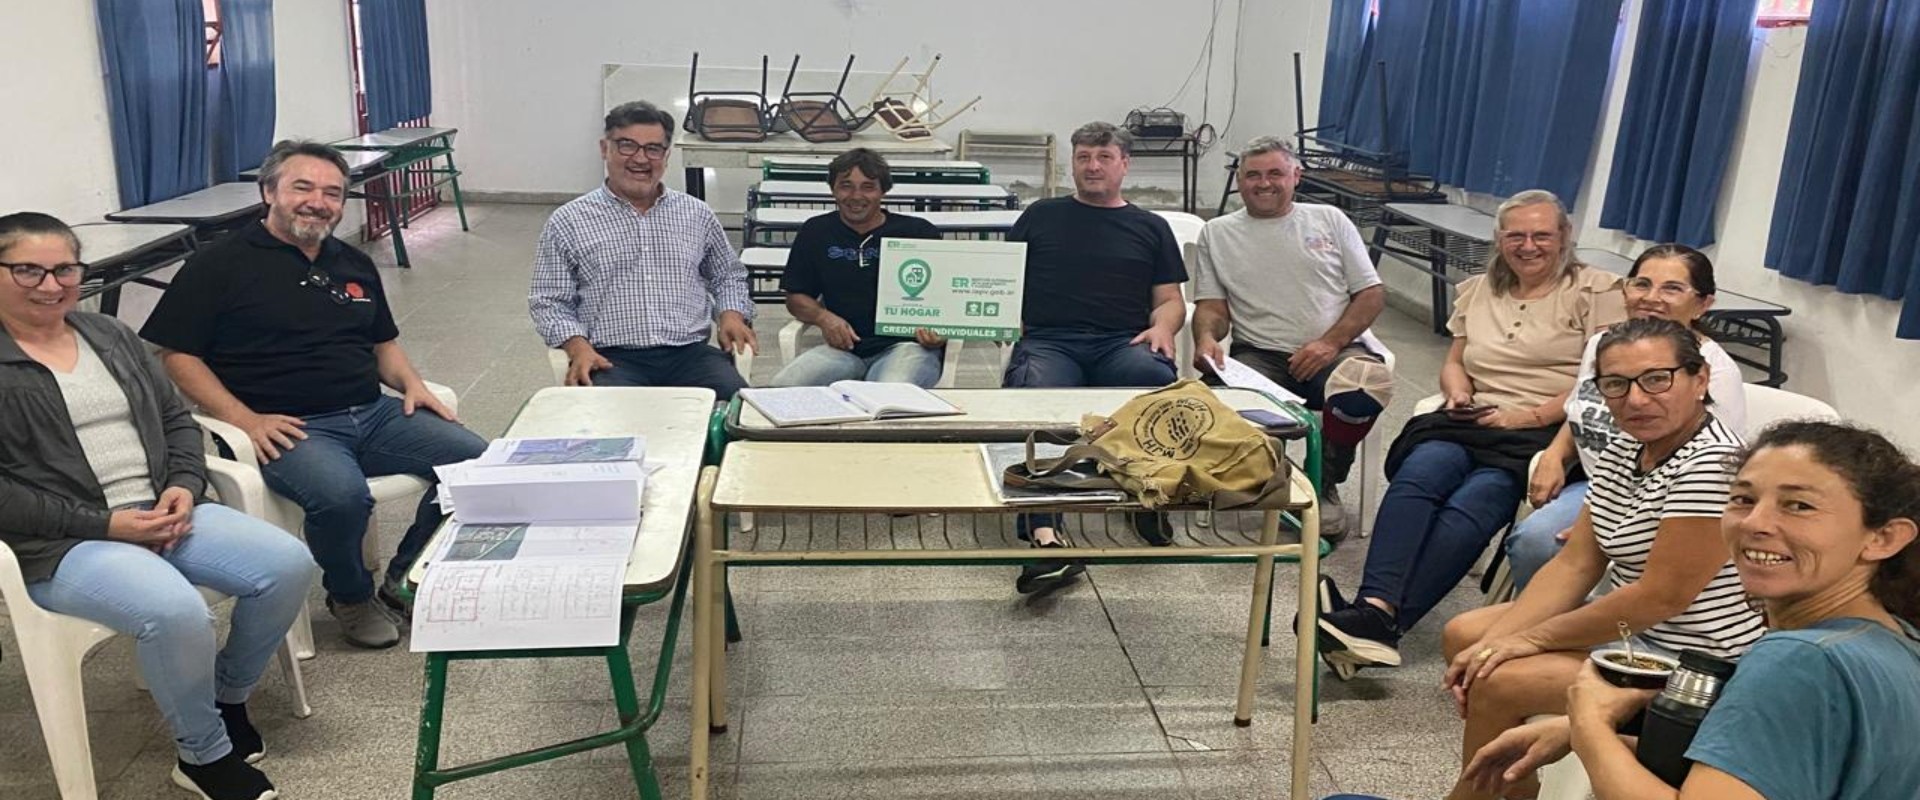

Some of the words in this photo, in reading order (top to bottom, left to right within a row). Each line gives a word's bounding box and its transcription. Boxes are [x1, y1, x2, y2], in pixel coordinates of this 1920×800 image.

[951, 277, 970, 288] ER
[884, 307, 898, 315] TU
[900, 307, 941, 317] HOGAR
[882, 325, 929, 336] CREDIT
[931, 327, 997, 337] INDIVIDUALES
[1142, 439, 1175, 458] MJH
